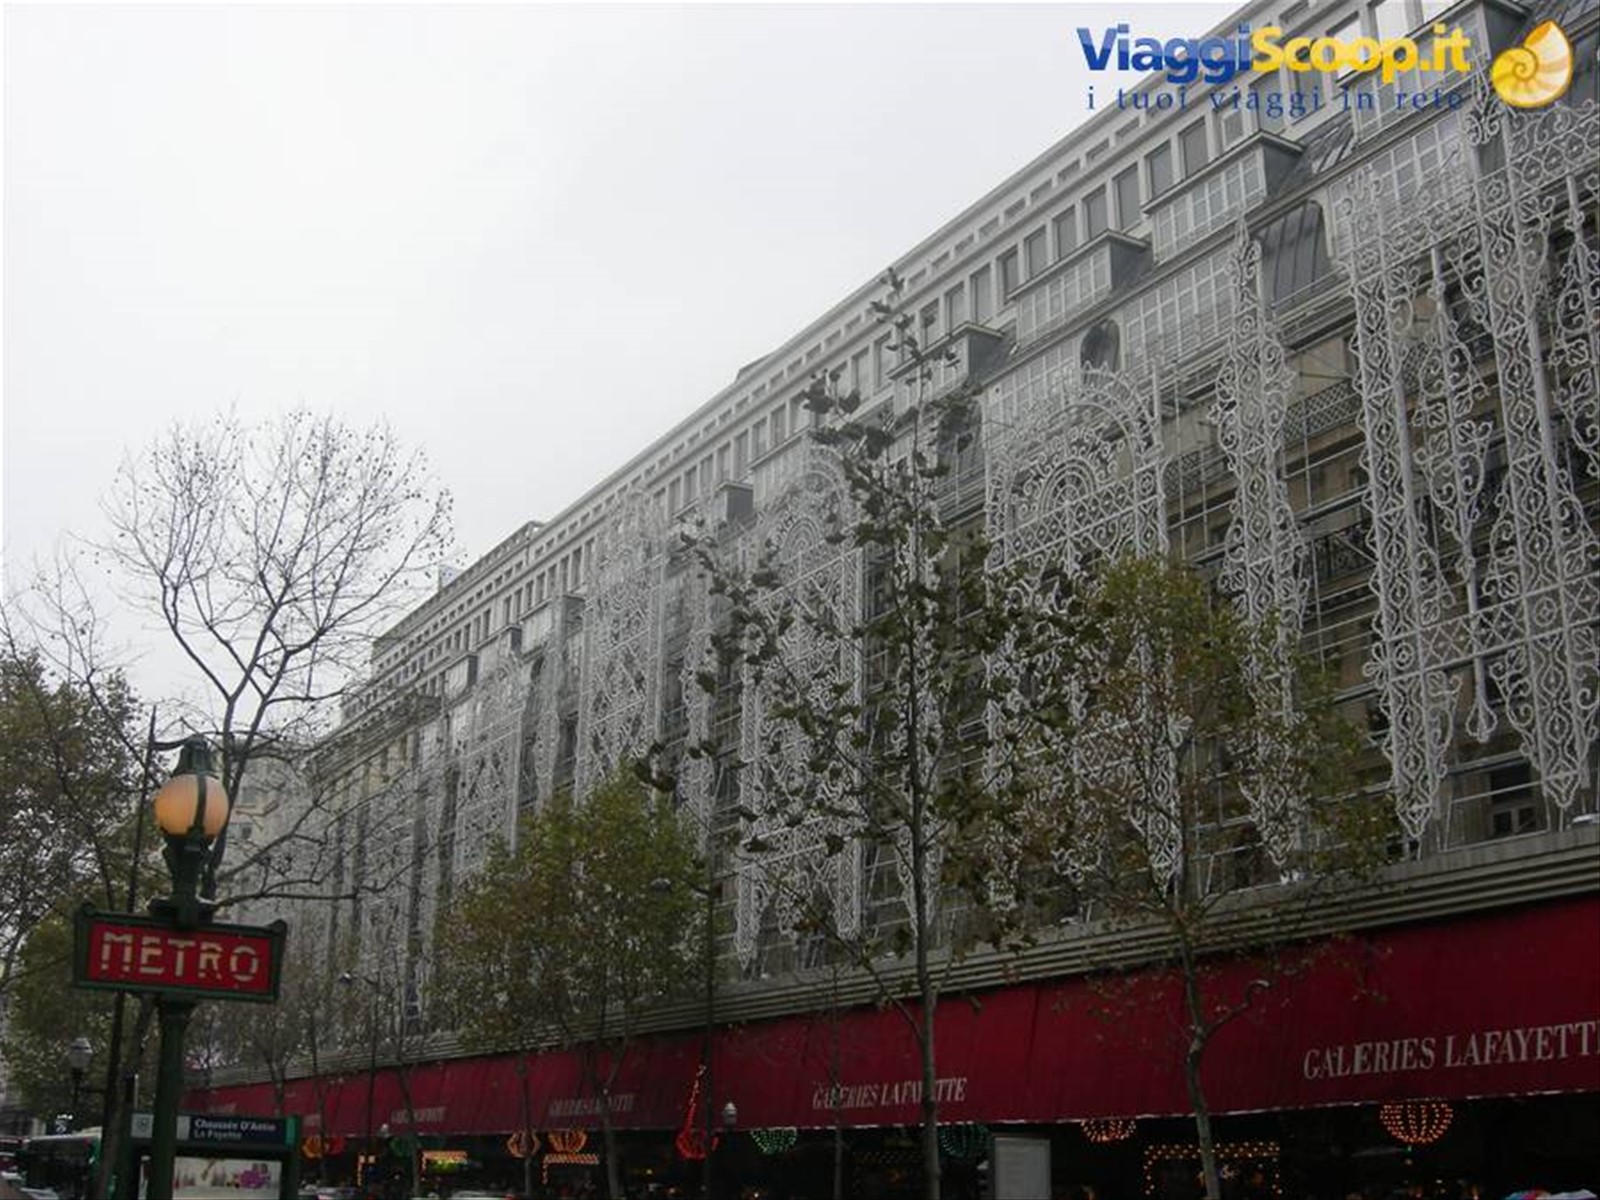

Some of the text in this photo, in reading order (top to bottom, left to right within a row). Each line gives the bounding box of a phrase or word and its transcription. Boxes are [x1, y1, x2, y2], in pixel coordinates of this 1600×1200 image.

[101, 931, 259, 982] METRO
[1303, 1020, 1600, 1080] GALERIES LAFAYETT
